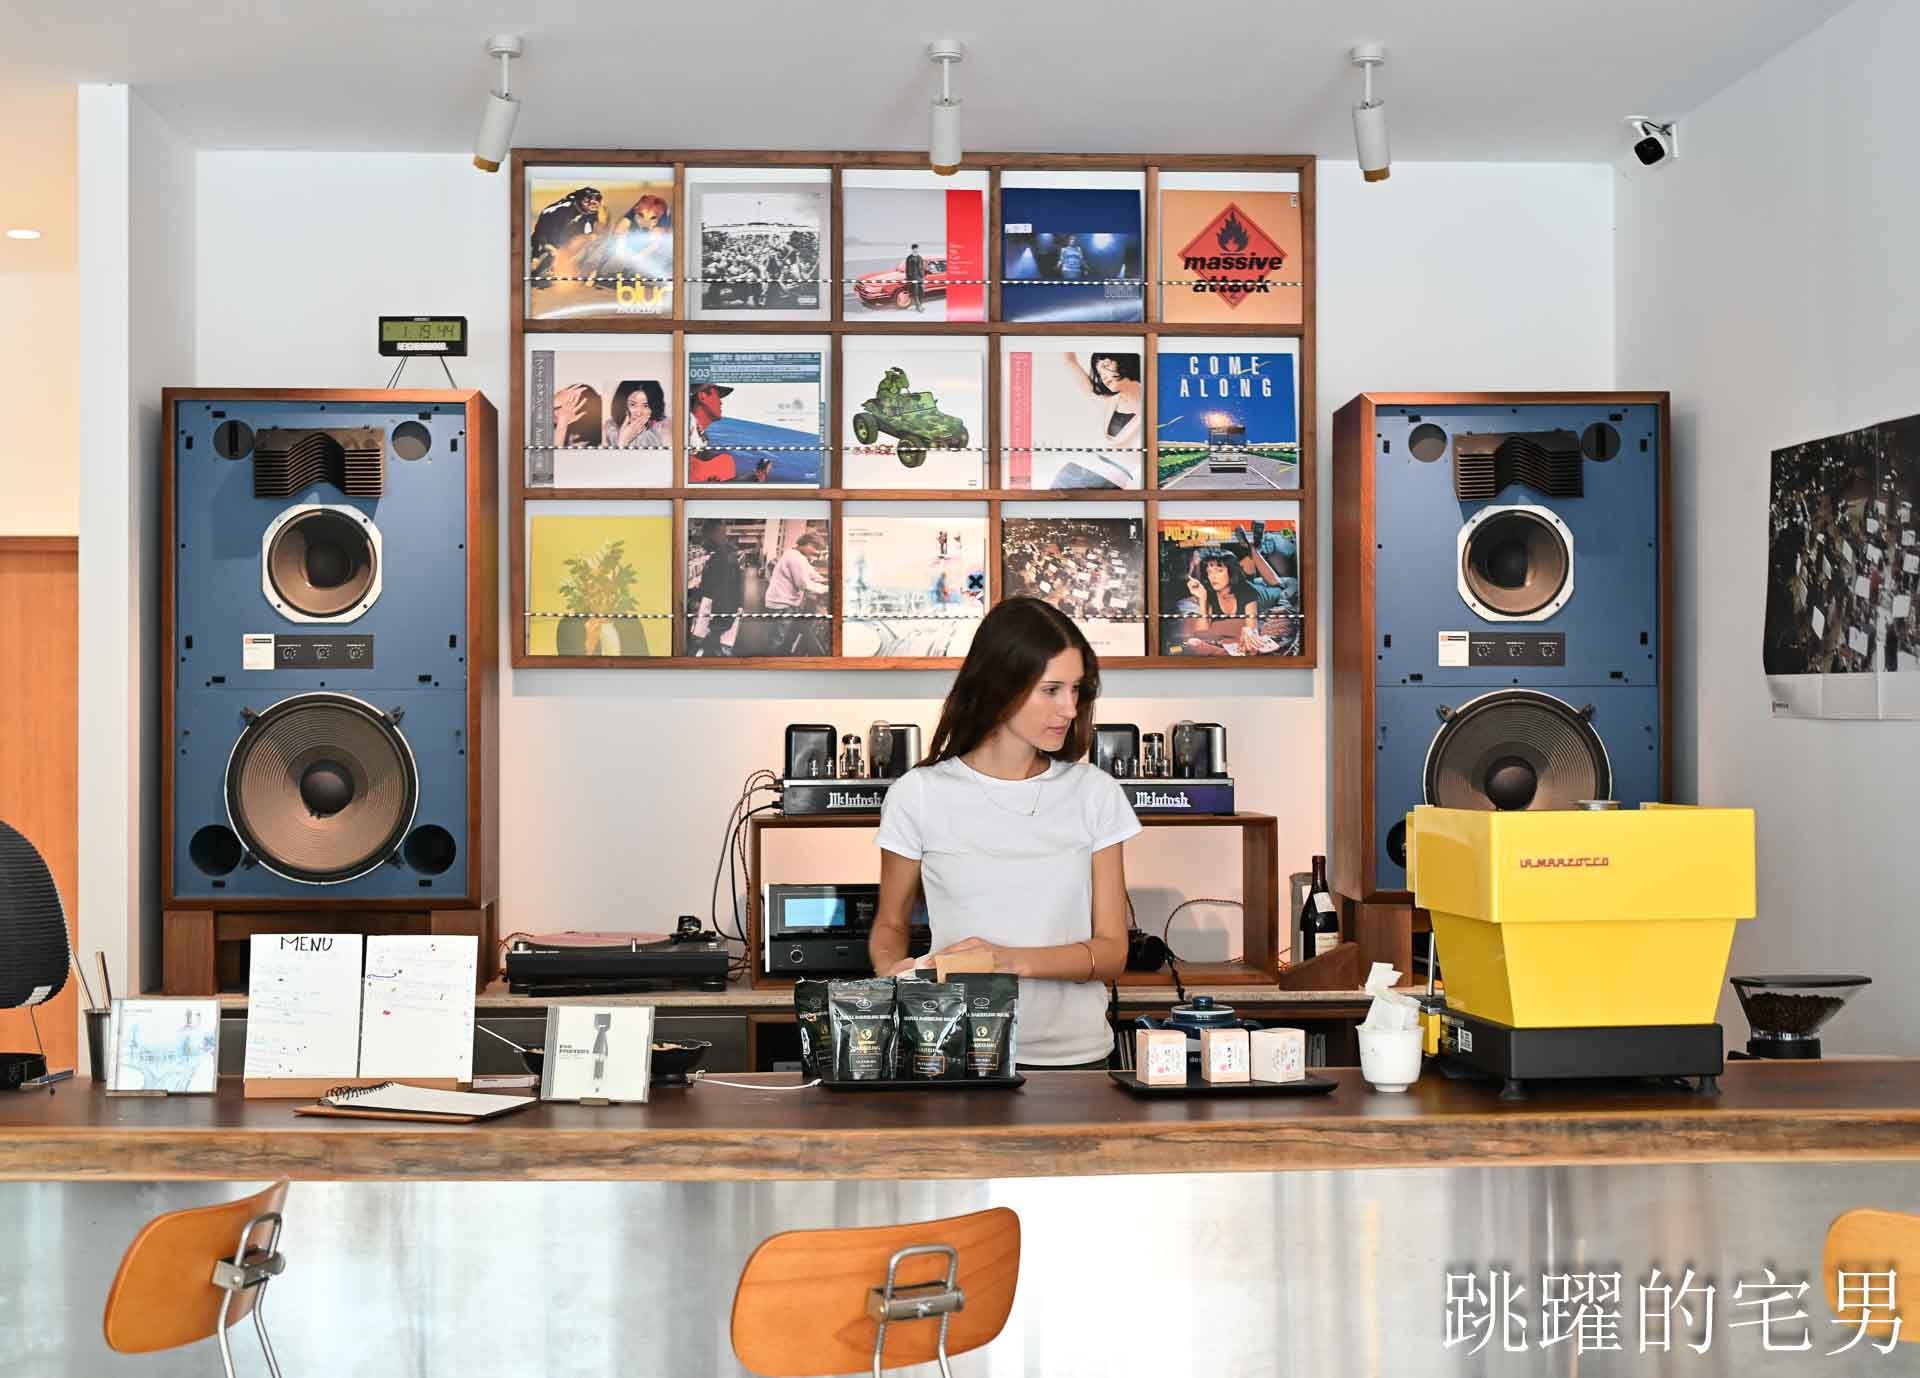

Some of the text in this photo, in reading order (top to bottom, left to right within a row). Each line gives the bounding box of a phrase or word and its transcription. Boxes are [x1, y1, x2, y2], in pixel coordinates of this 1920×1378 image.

[1184, 252, 1283, 270] massive
[616, 272, 672, 304] blur
[1193, 275, 1271, 293] attack
[690, 368, 711, 378] 003
[1189, 356, 1260, 375] COME
[1180, 378, 1272, 397] ALONG
[1133, 791, 1192, 808] McIntosh
[280, 936, 333, 951] MENU
